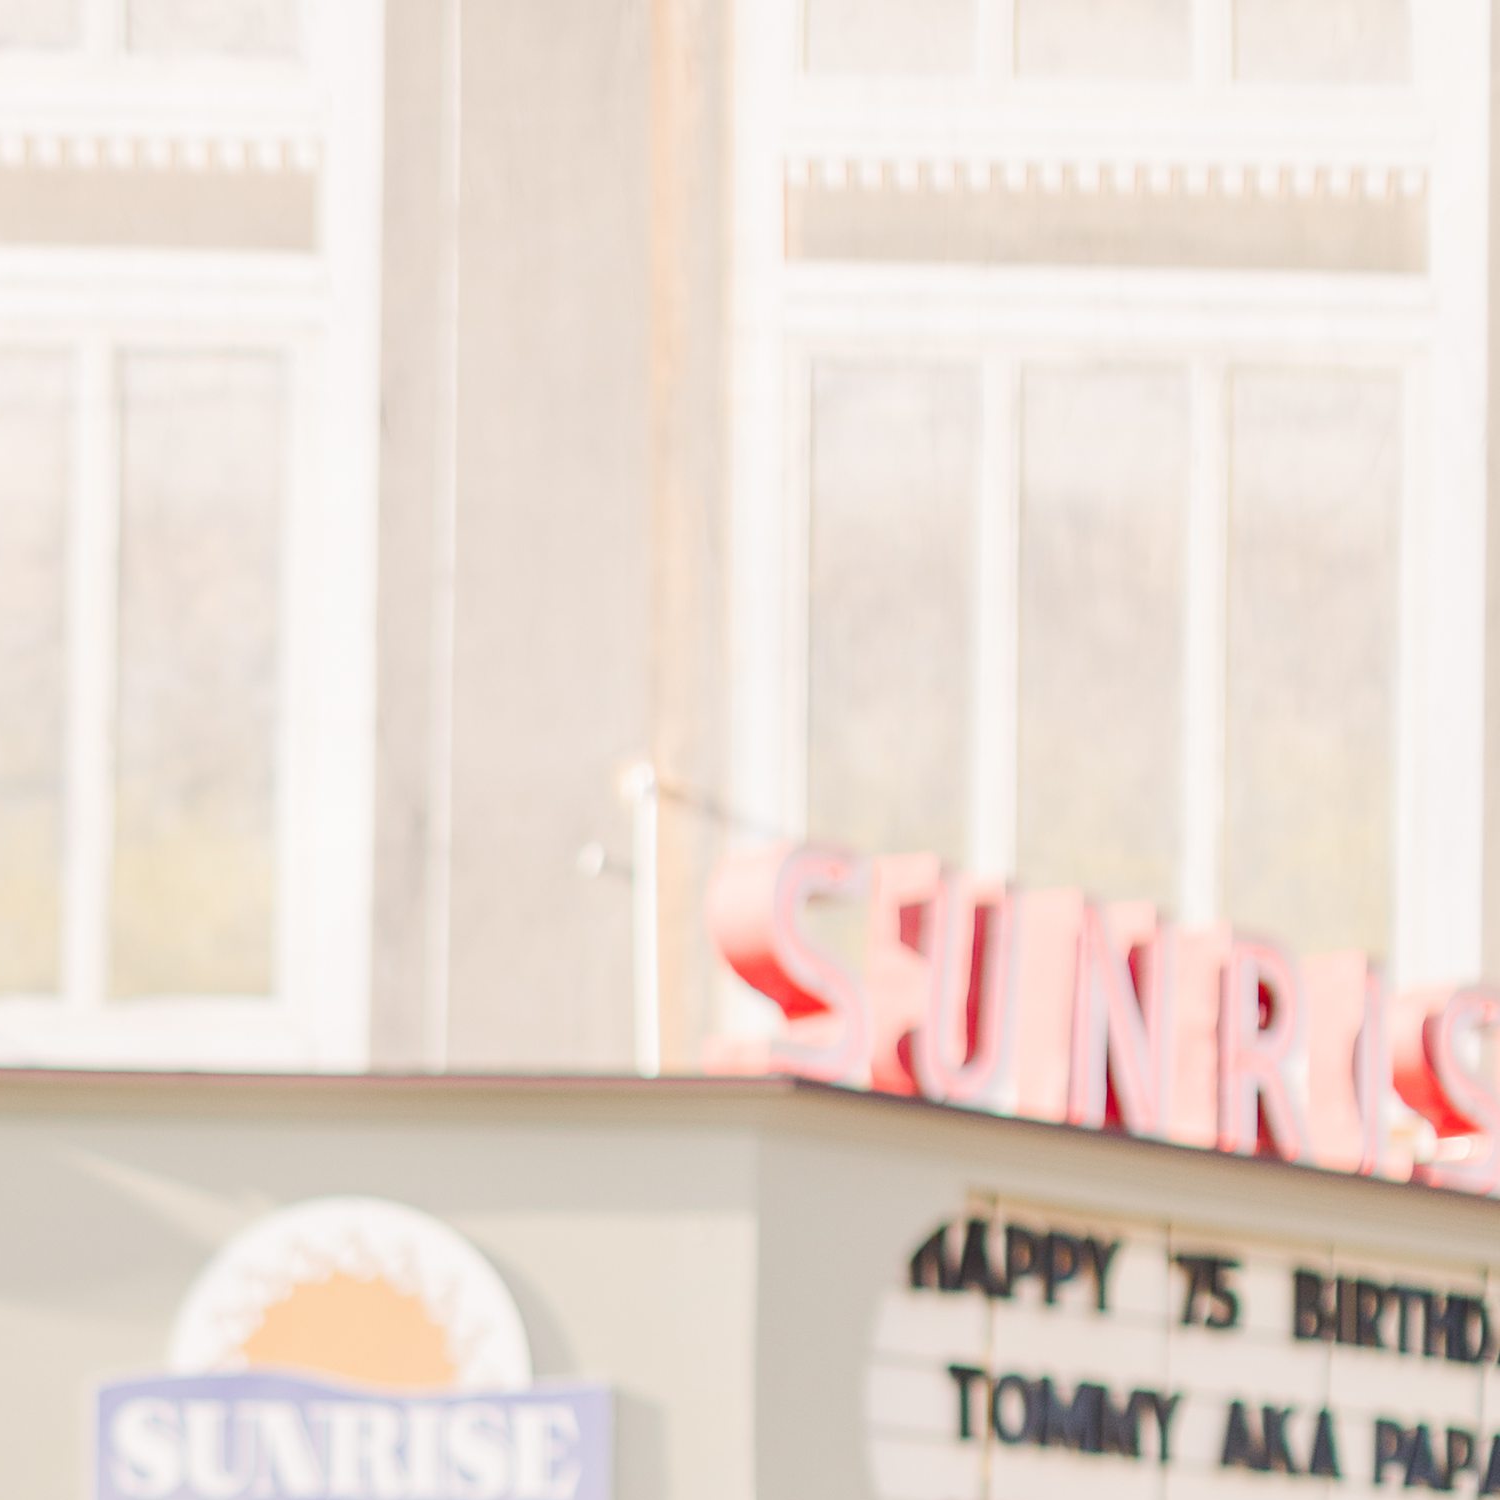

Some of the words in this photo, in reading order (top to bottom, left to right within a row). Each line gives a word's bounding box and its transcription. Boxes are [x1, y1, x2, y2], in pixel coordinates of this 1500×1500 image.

[909, 1217, 1121, 1313] HAPPY
[1176, 1253, 1243, 1329] 75
[1294, 1267, 1500, 1366] BIRTHD
[948, 1364, 1181, 1463] TOMMY
[1220, 1400, 1342, 1479] AKA
